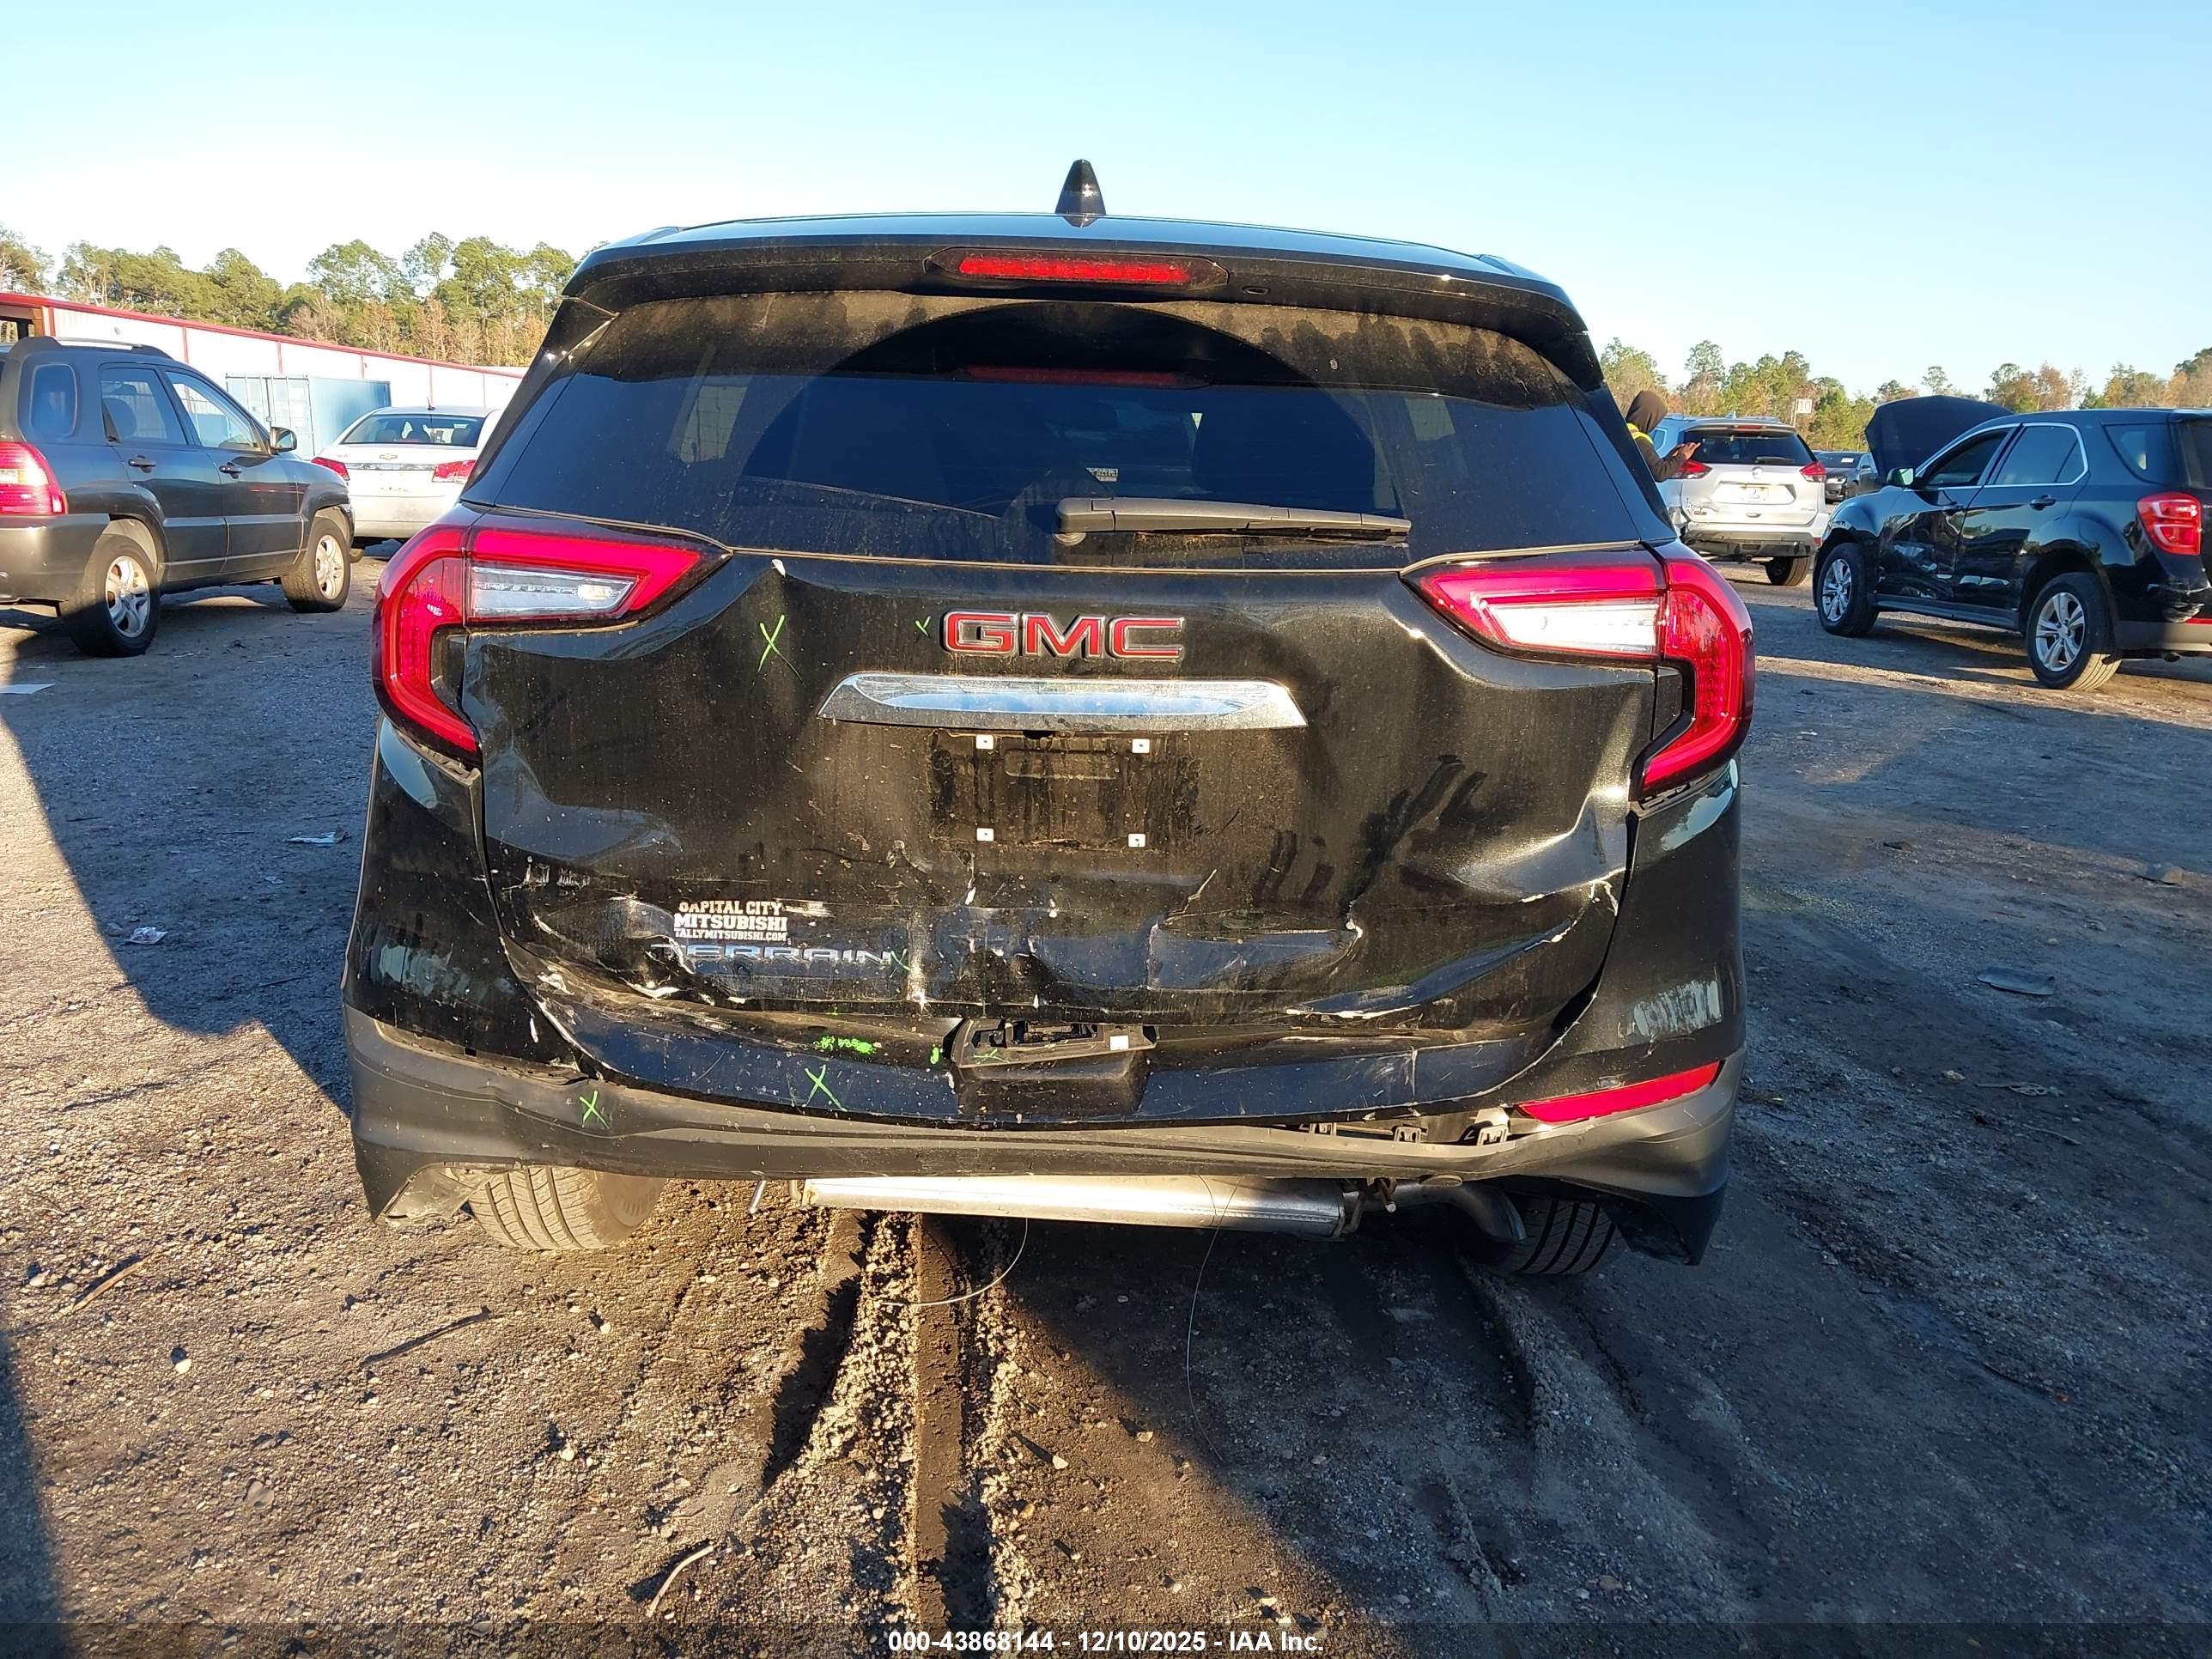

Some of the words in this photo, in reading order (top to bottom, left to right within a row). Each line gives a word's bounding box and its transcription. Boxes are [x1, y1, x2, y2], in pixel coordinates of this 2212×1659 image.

[943, 610, 1186, 659] GMC
[678, 900, 744, 915] CAPITAL
[745, 901, 783, 915] CITY
[673, 913, 787, 932] MITSUBISHI
[673, 927, 787, 942] TALLYMITSUBISHI.COM
